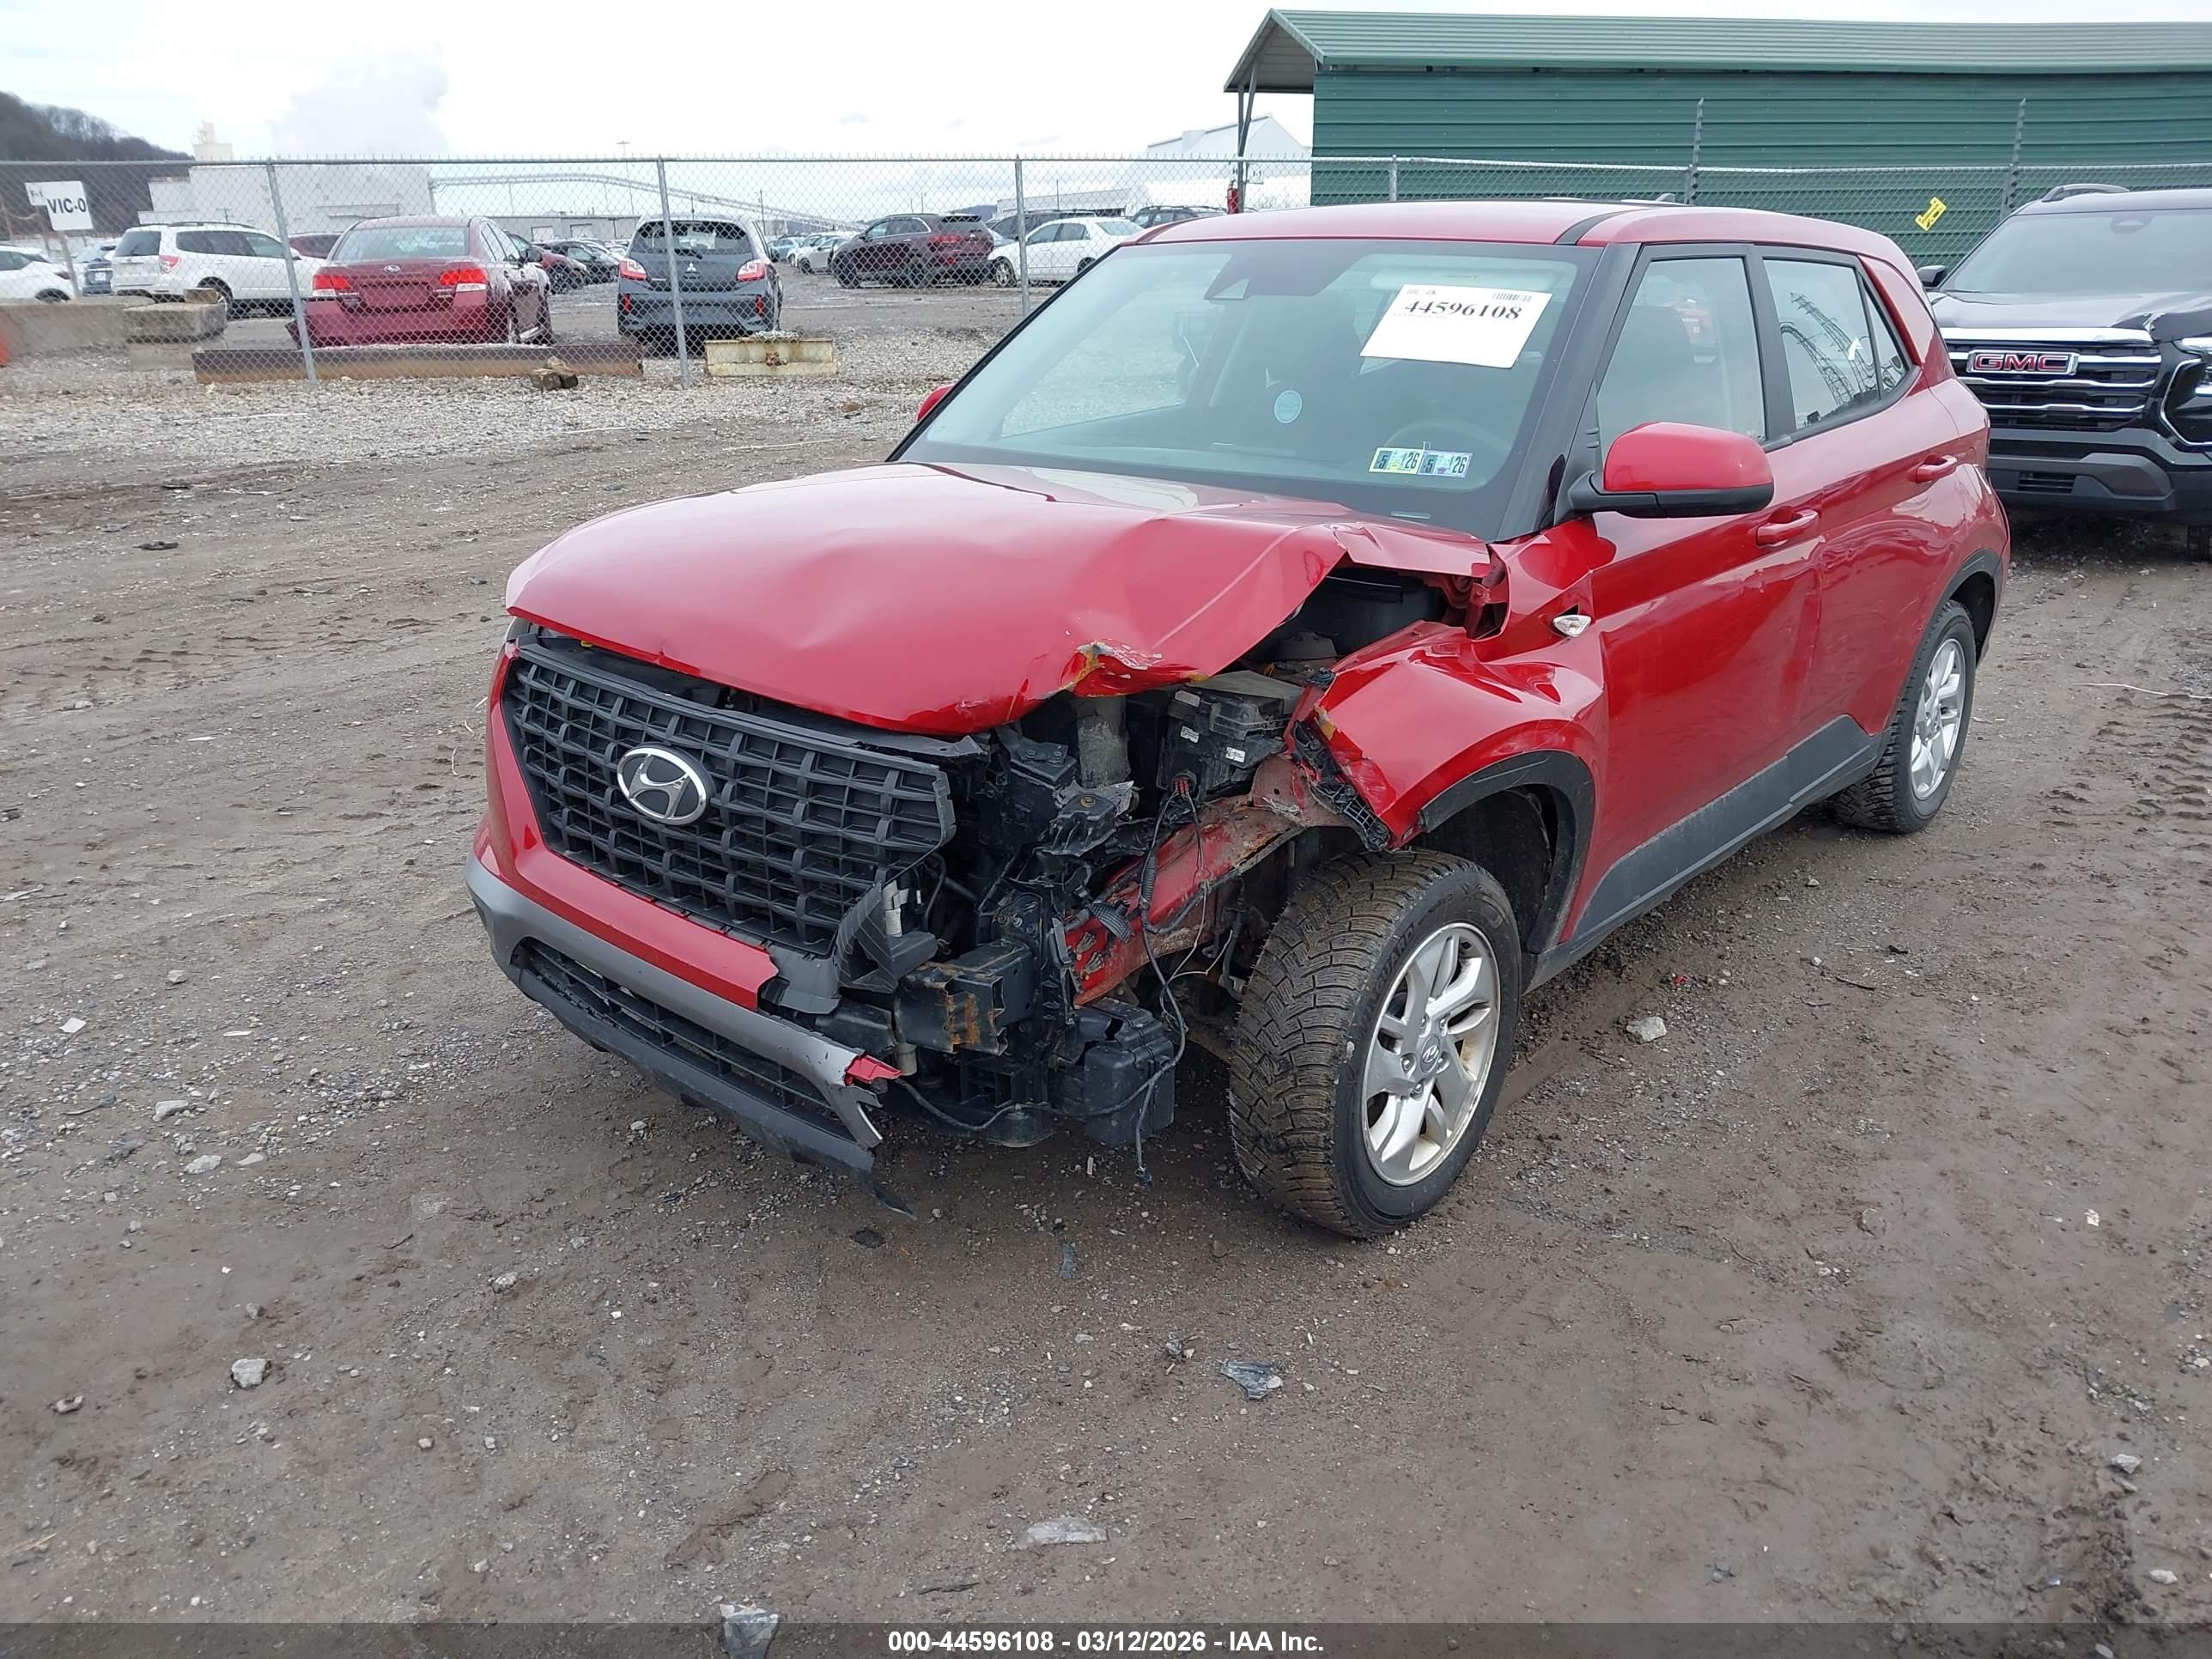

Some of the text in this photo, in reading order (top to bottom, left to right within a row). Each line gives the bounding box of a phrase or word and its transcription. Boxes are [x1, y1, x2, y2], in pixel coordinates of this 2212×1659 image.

[46, 198, 87, 213] VIC-0
[1404, 301, 1522, 320] 44596108
[1974, 353, 2069, 372] GMC
